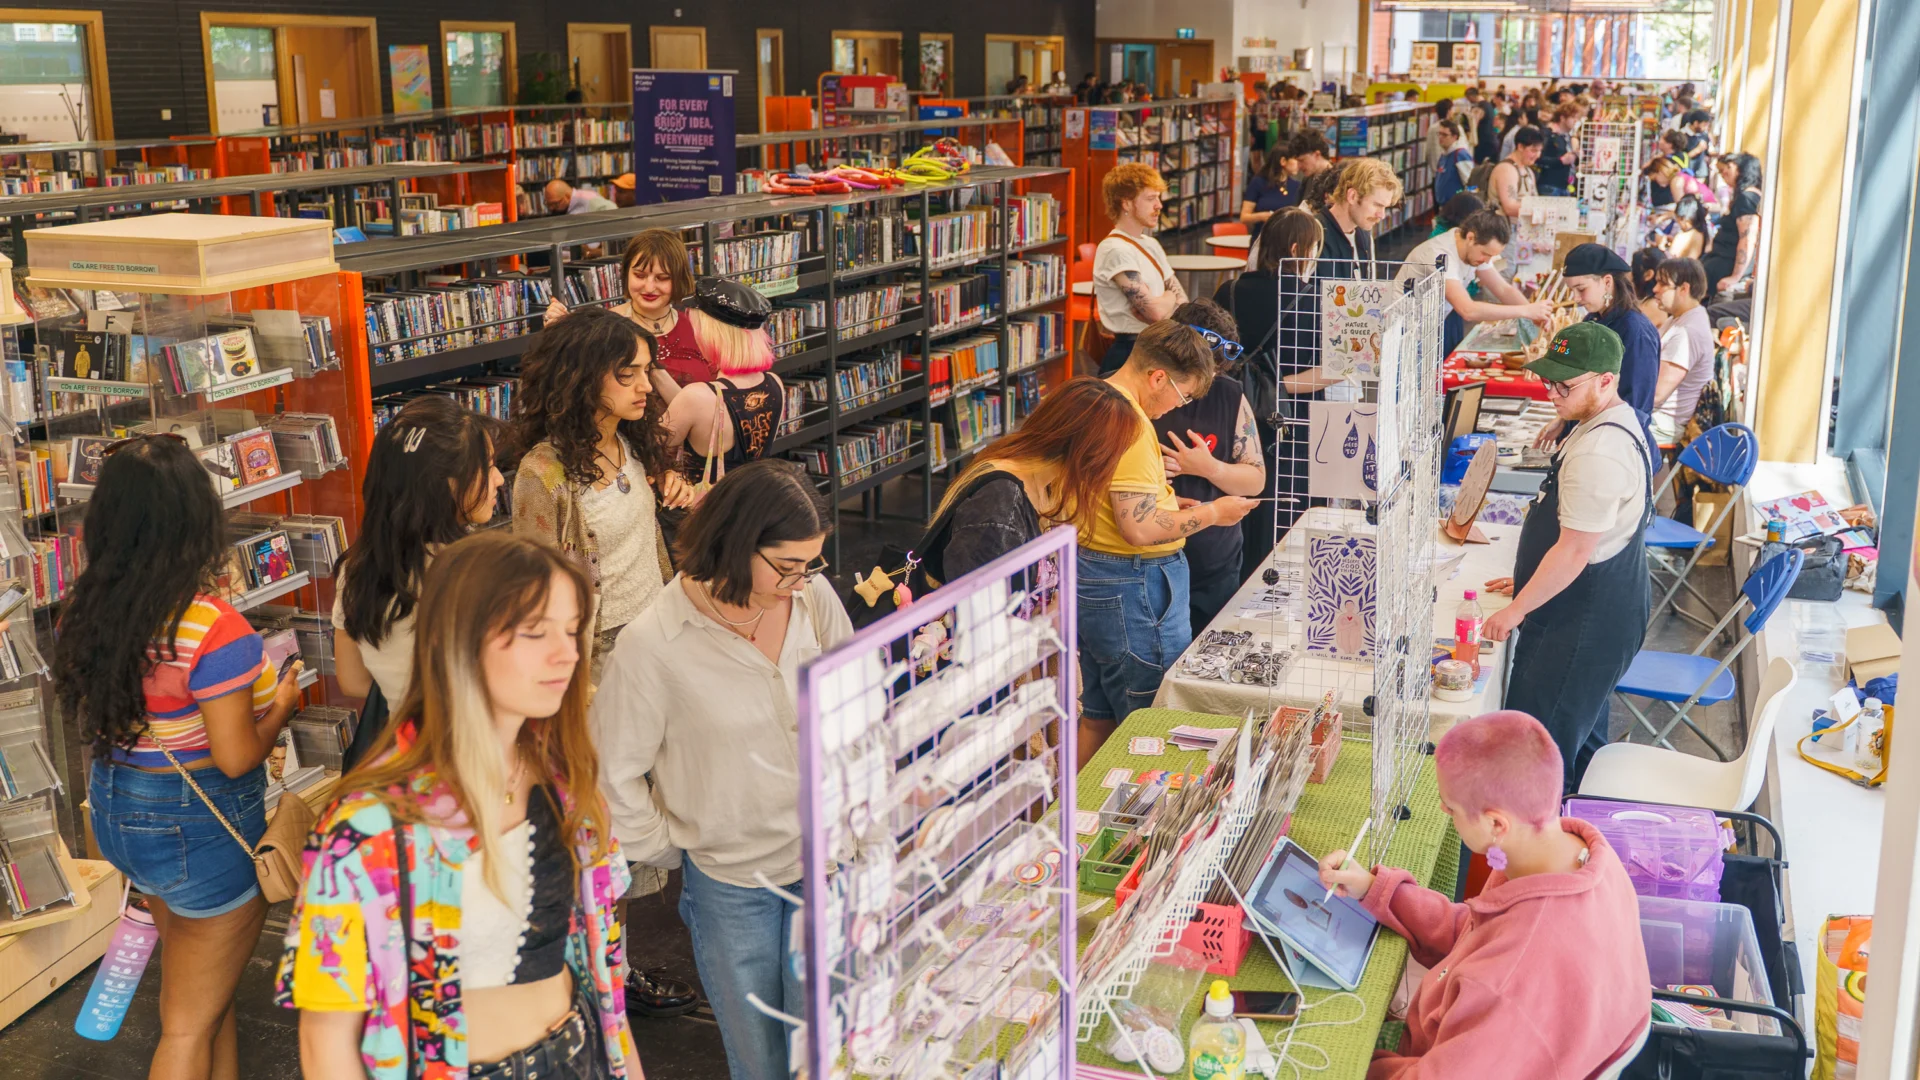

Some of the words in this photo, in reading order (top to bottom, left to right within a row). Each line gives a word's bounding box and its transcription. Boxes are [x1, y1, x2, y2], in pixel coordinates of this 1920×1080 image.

[660, 99, 677, 110] FOR
[679, 100, 708, 111] EVERY
[654, 116, 687, 128] BRIGHT
[655, 134, 714, 146] EVERYWHERE
[105, 315, 115, 330] F
[113, 387, 142, 395] BORROW!
